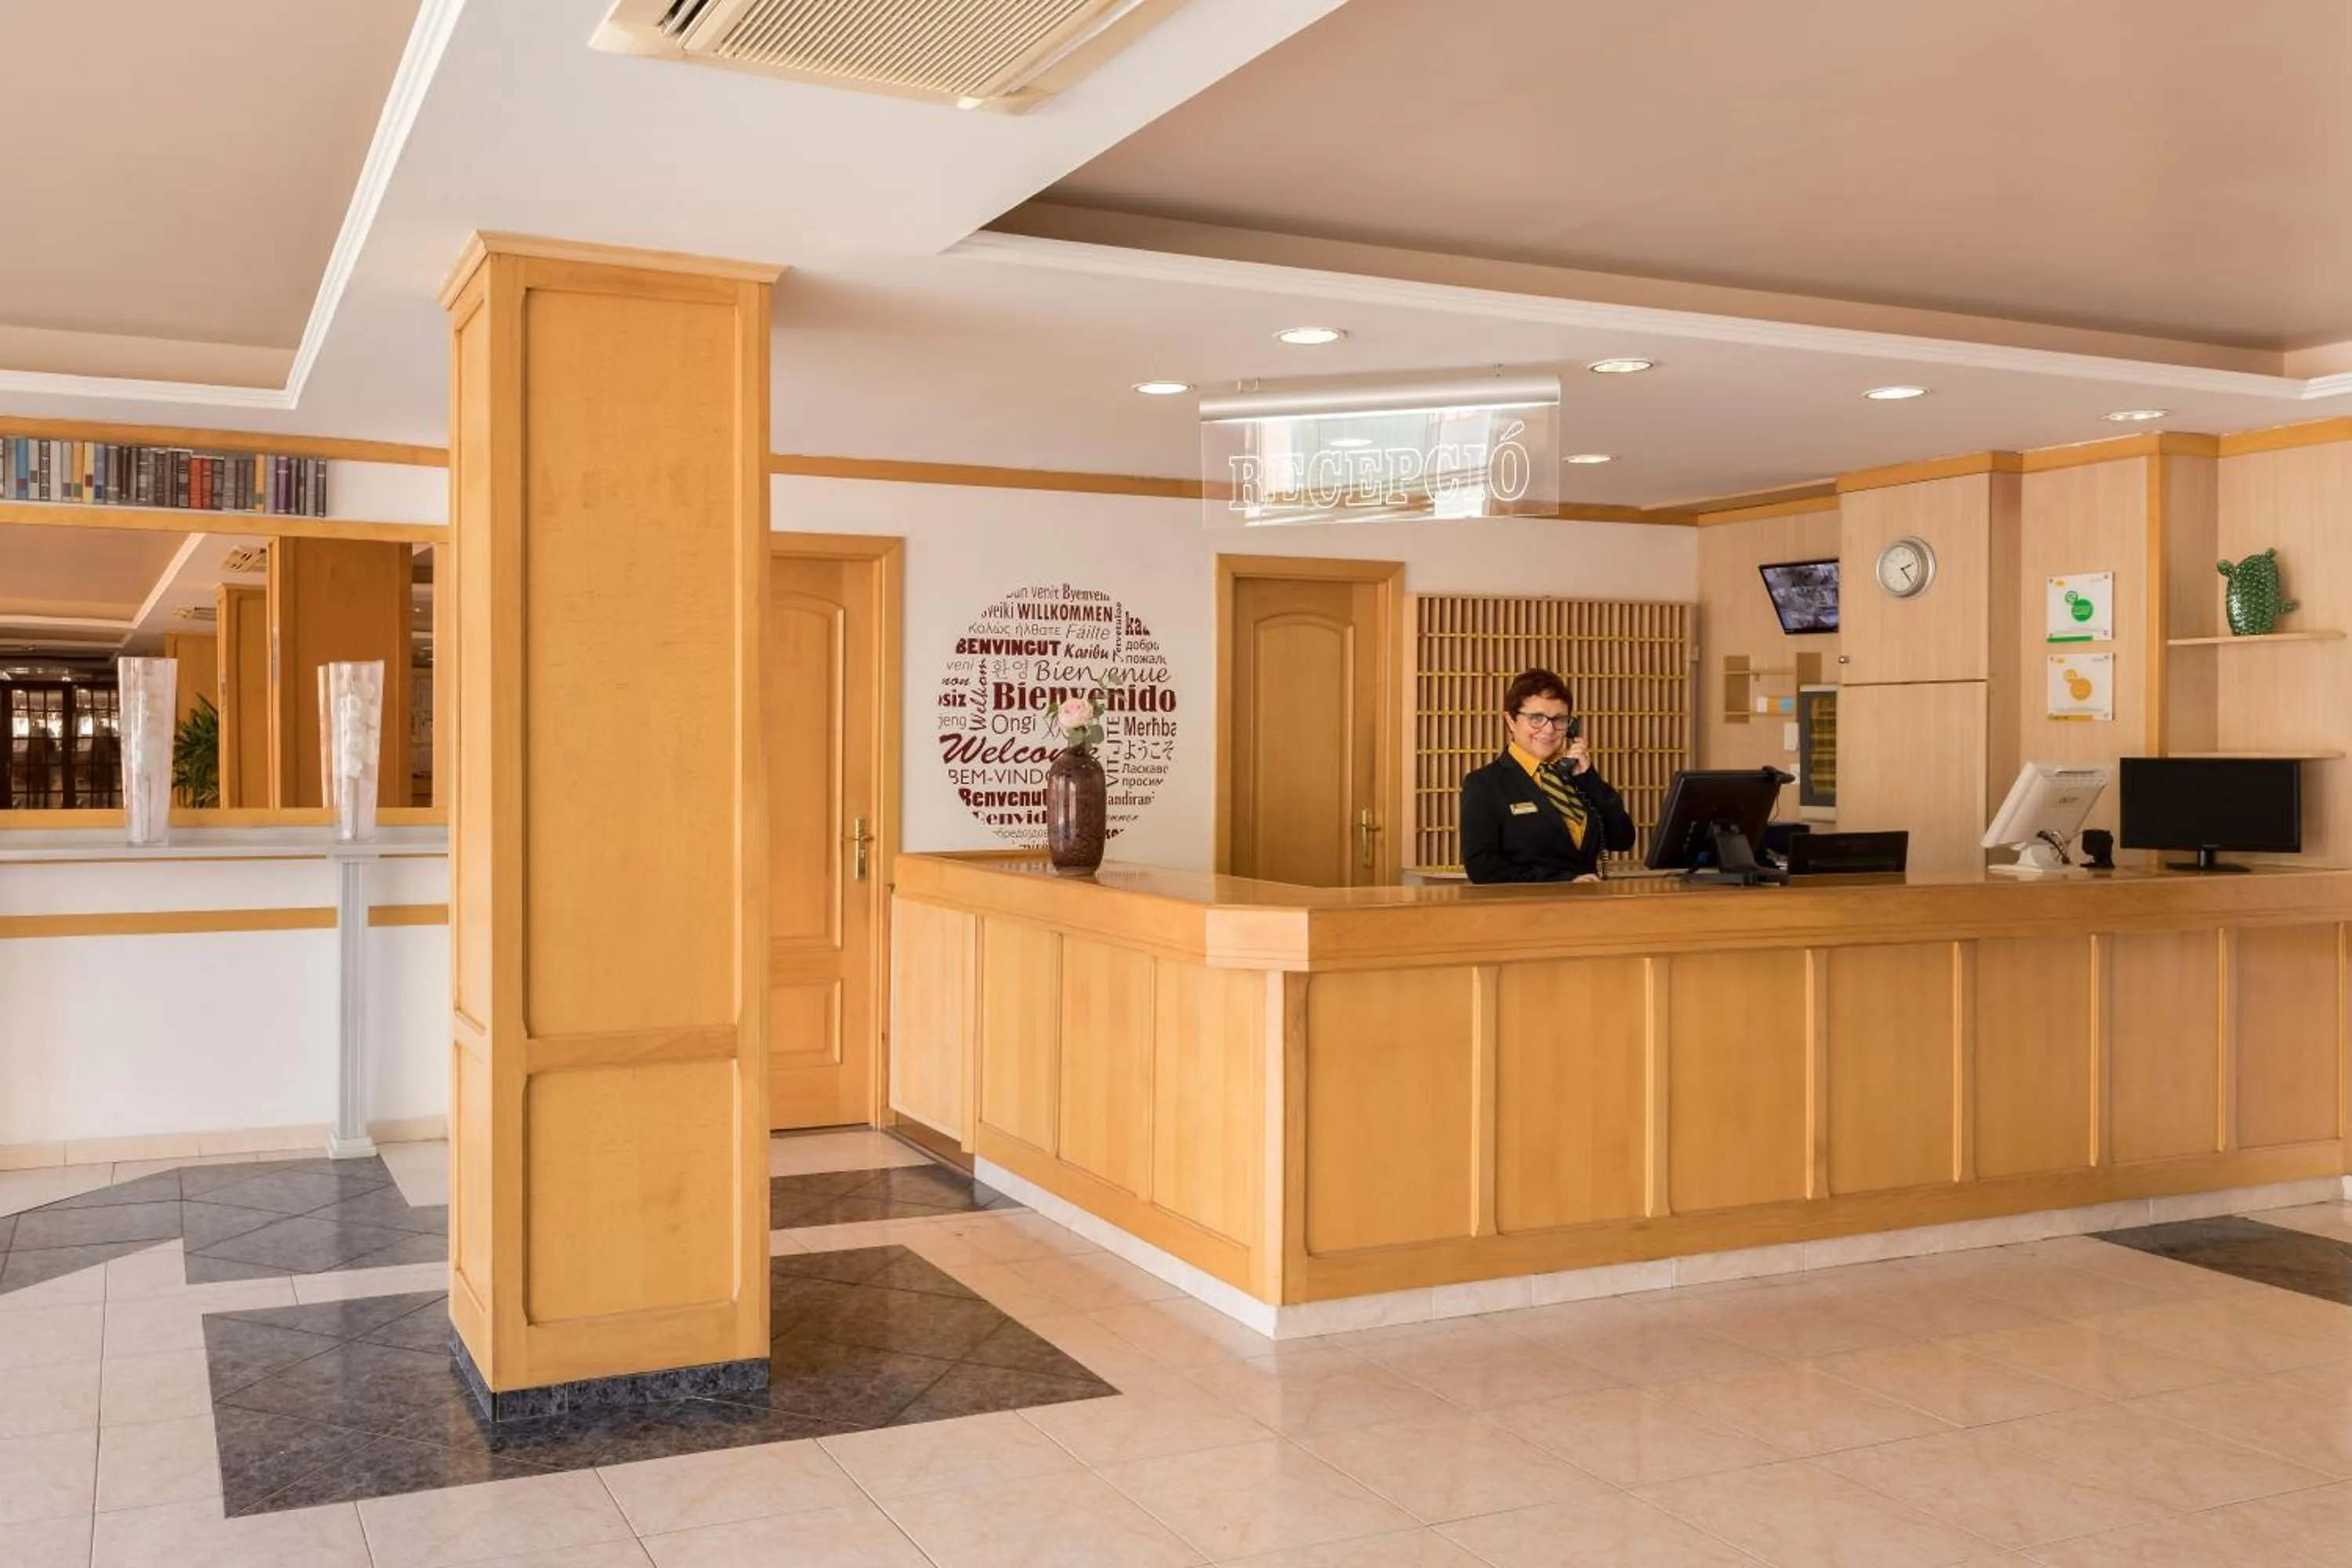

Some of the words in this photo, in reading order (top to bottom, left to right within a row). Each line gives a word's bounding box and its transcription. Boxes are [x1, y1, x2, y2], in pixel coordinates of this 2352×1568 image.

[1229, 420, 1530, 510] RECEPCIÓ
[1018, 603, 1112, 622] WILLKOMMEN
[956, 638, 1061, 656] BENVINGUT
[1064, 643, 1109, 661] Karibu
[993, 659, 1029, 679] 환영
[1034, 660, 1171, 683] Bienenue
[938, 689, 967, 707] siz
[992, 714, 1036, 734] Ongi
[1123, 740, 1174, 760] ようこそ
[971, 810, 1047, 826] envid
